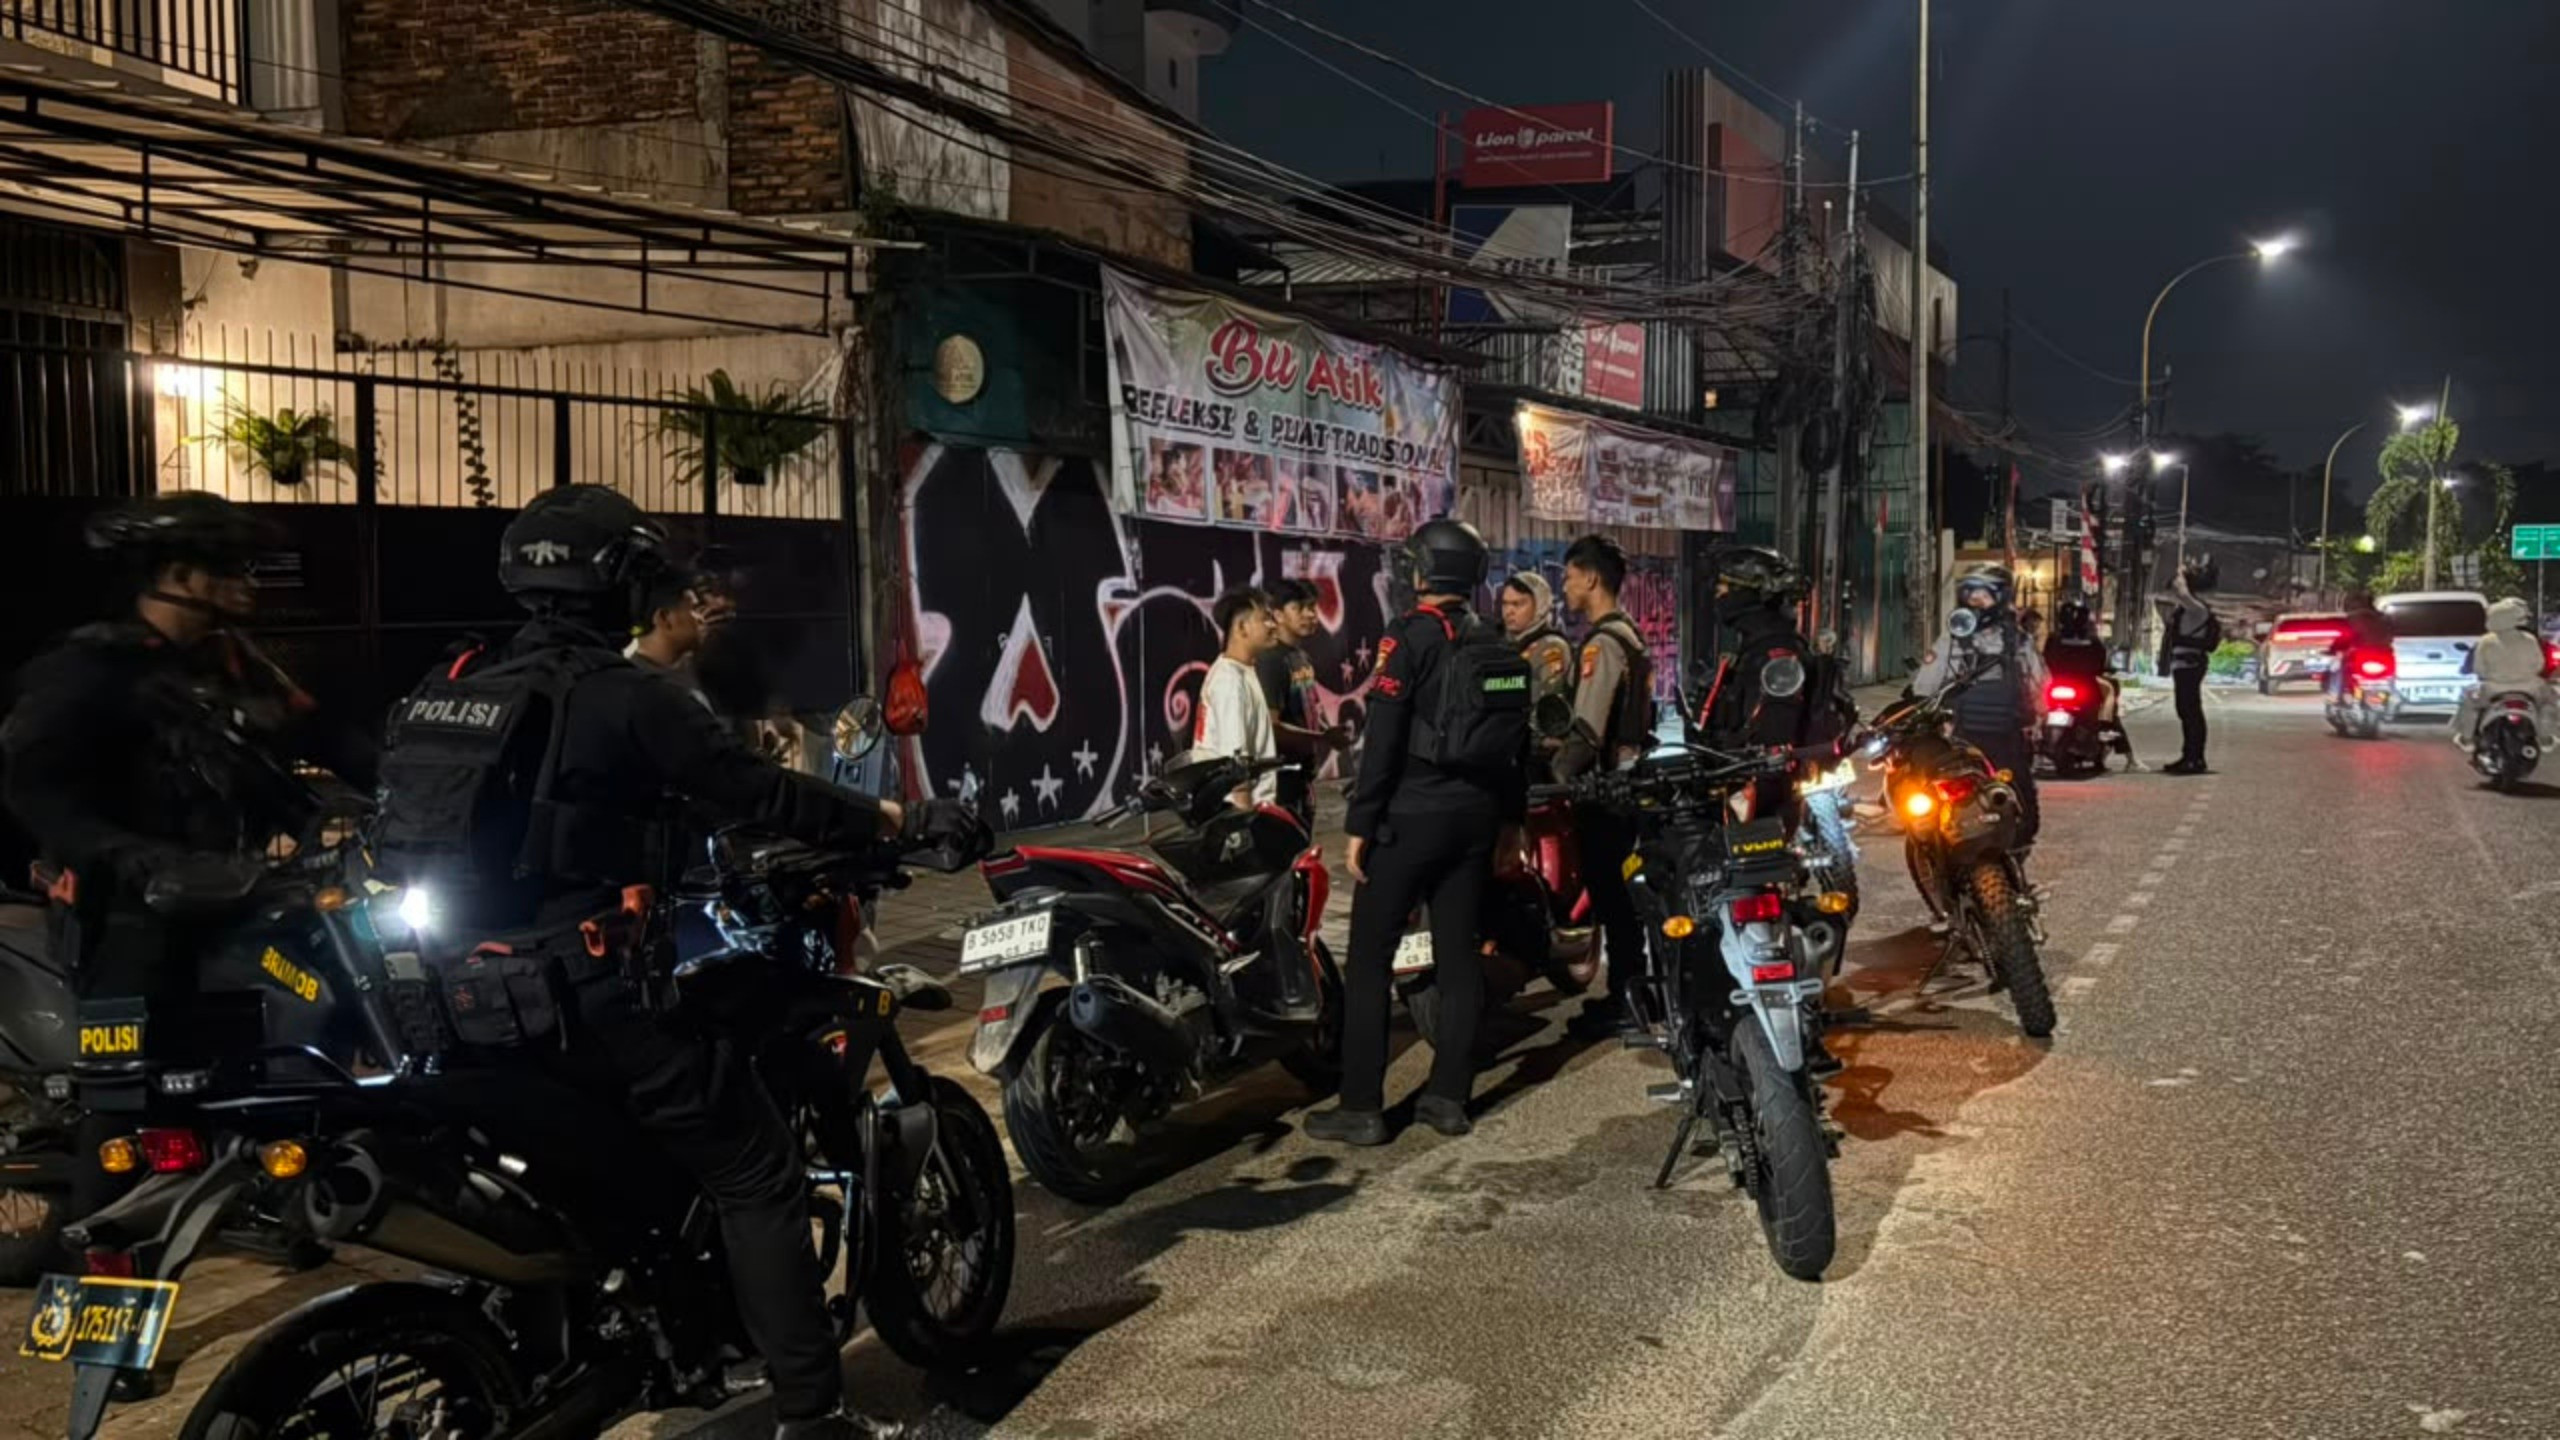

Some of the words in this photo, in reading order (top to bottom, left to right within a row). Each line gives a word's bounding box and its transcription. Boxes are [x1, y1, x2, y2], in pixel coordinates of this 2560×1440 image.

[1475, 132, 1515, 147] Lion
[1206, 318, 1298, 393] Bu
[1306, 350, 1382, 407] Atik
[1121, 384, 1234, 431] REFLEKSI
[1243, 410, 1259, 436] &
[408, 701, 500, 727] POLISI
[967, 933, 977, 950] B
[81, 1025, 139, 1053] POLISI
